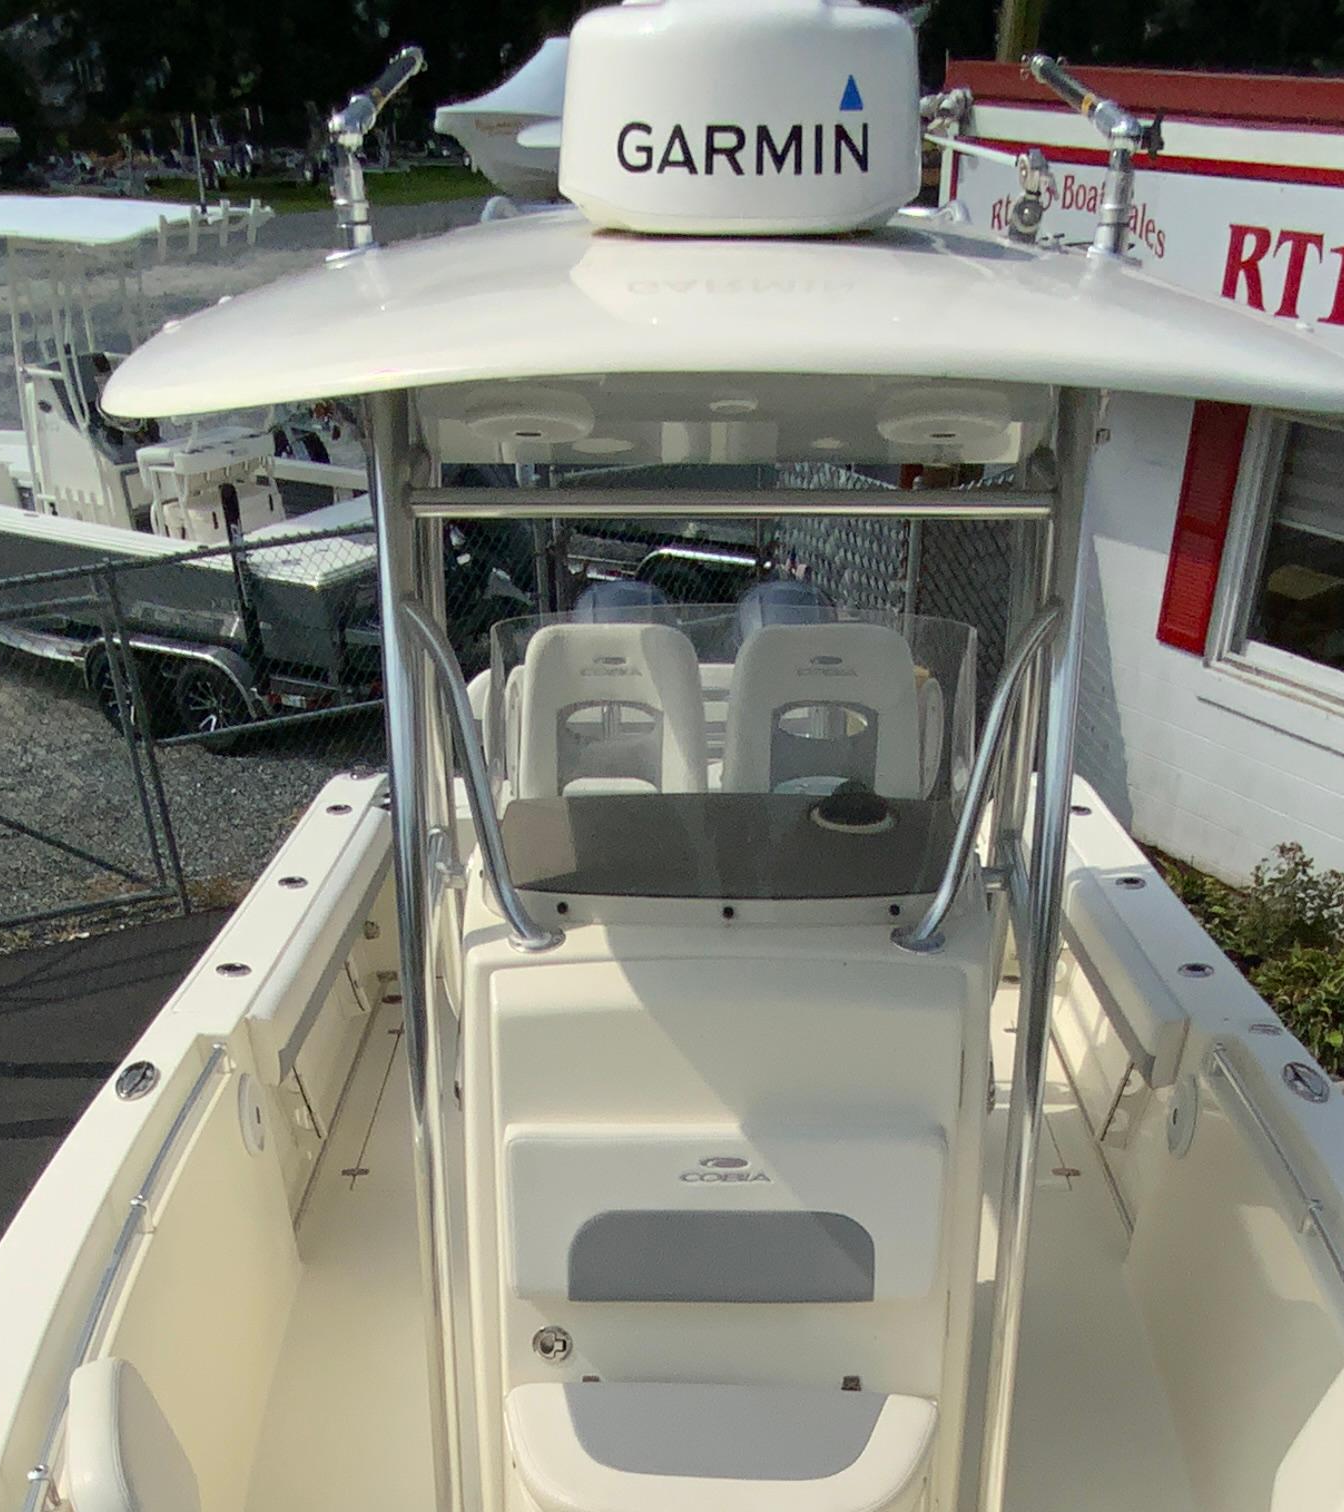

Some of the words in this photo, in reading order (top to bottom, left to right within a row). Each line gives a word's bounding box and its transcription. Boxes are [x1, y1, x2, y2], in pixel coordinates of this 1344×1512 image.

[617, 122, 869, 177] GARMIN
[1127, 194, 1167, 260] ales
[679, 1172, 772, 1183] COBIA
